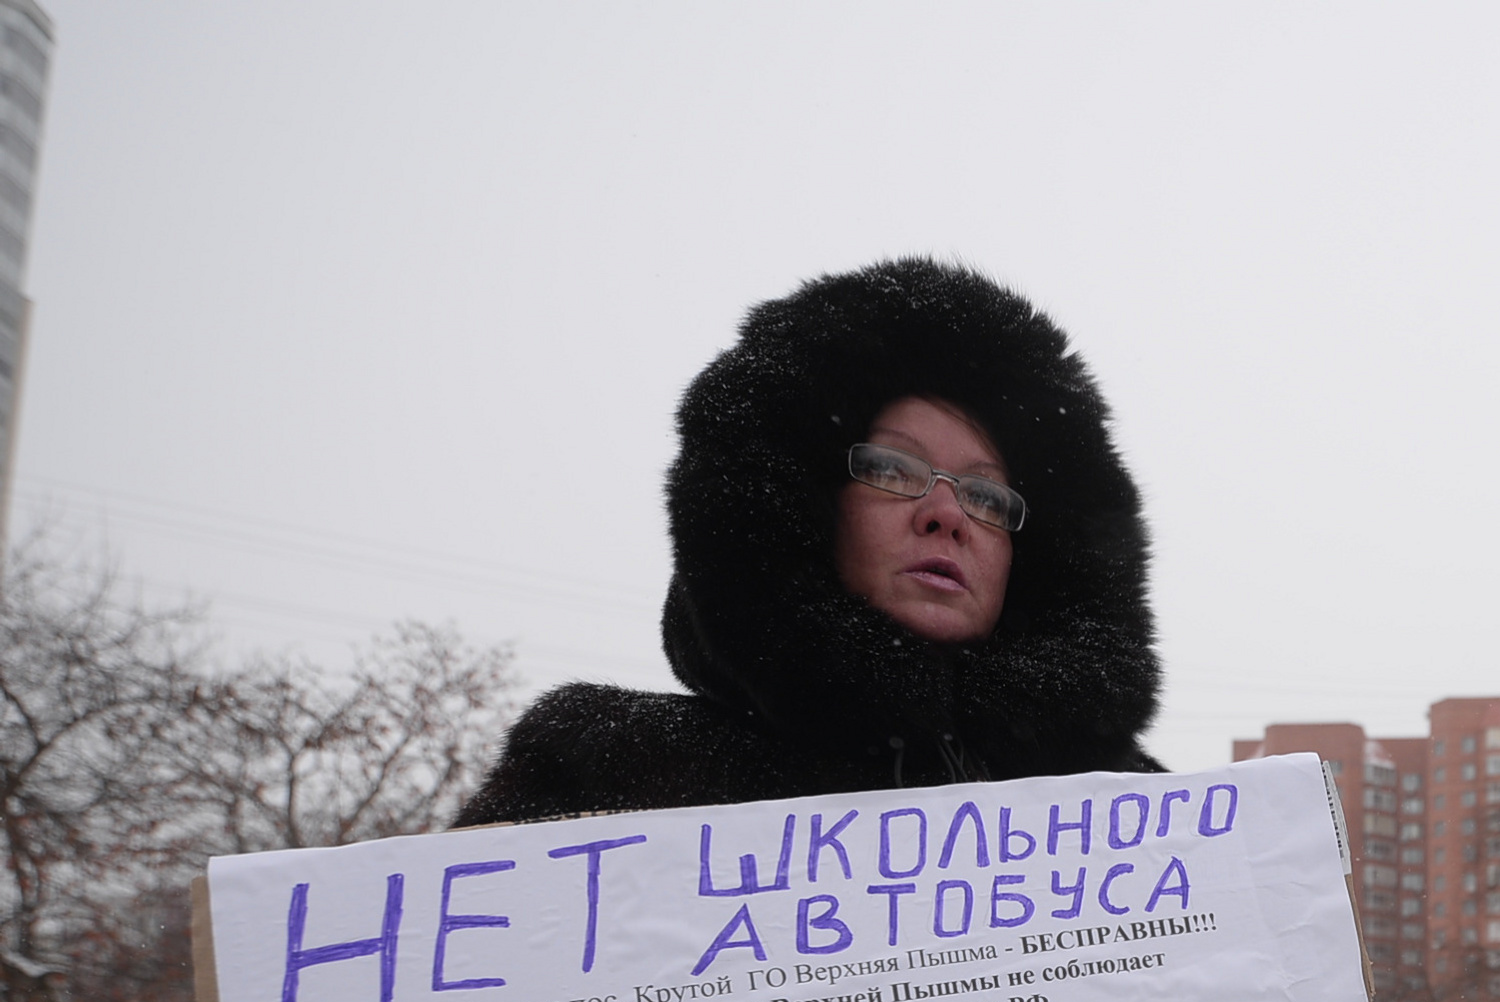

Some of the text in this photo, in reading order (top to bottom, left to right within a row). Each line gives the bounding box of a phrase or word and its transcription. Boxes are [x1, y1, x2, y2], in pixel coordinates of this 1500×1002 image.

[698, 784, 1238, 897] ШКОЛЬНОГО
[690, 856, 1190, 976] АВТОБУСА
[747, 968, 786, 990] ГО
[793, 958, 899, 985] Верхняя
[907, 946, 998, 969] Пышма
[1019, 912, 1217, 955] БЕСПРАВНЫ!!!
[890, 975, 1000, 1002] Пышмы
[1007, 970, 1035, 986] не
[1043, 952, 1166, 982] соблюдает
